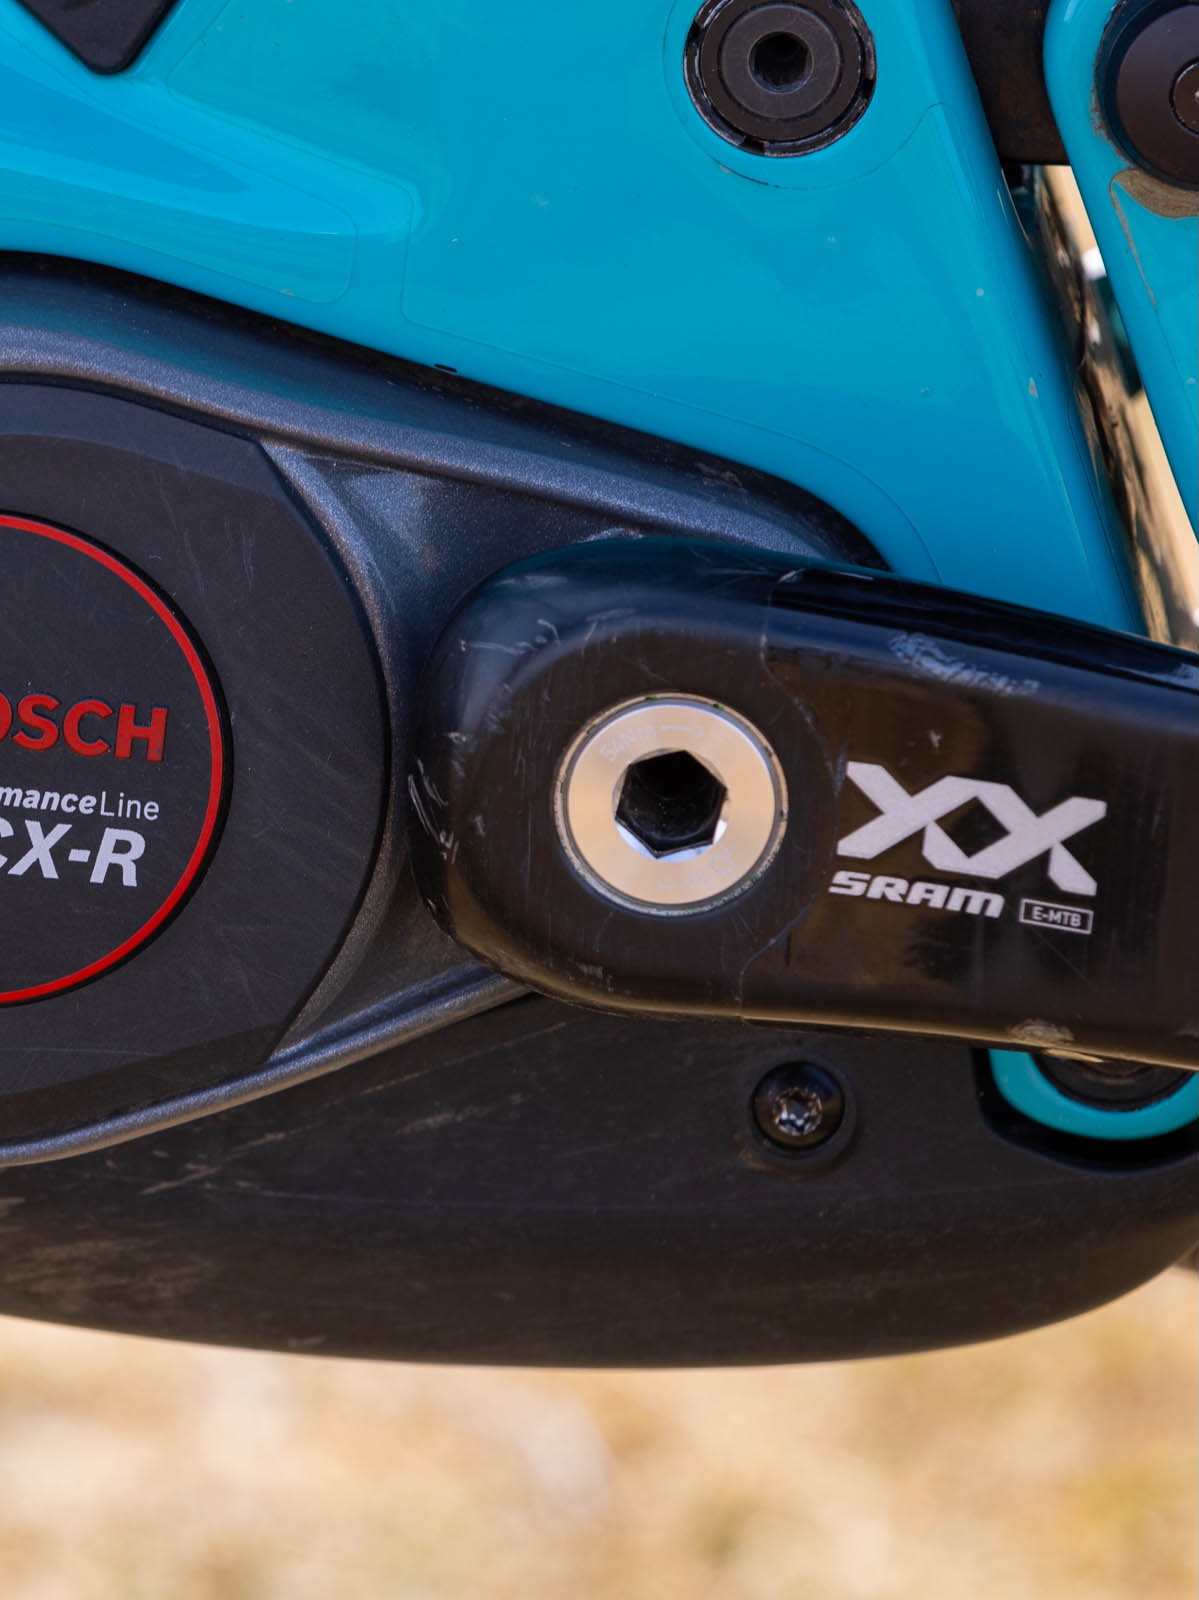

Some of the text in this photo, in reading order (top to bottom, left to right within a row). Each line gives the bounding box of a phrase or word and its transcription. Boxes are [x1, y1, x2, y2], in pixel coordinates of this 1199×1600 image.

[836, 761, 1107, 896] XX
[828, 870, 1082, 927] SRAM E-MTB
